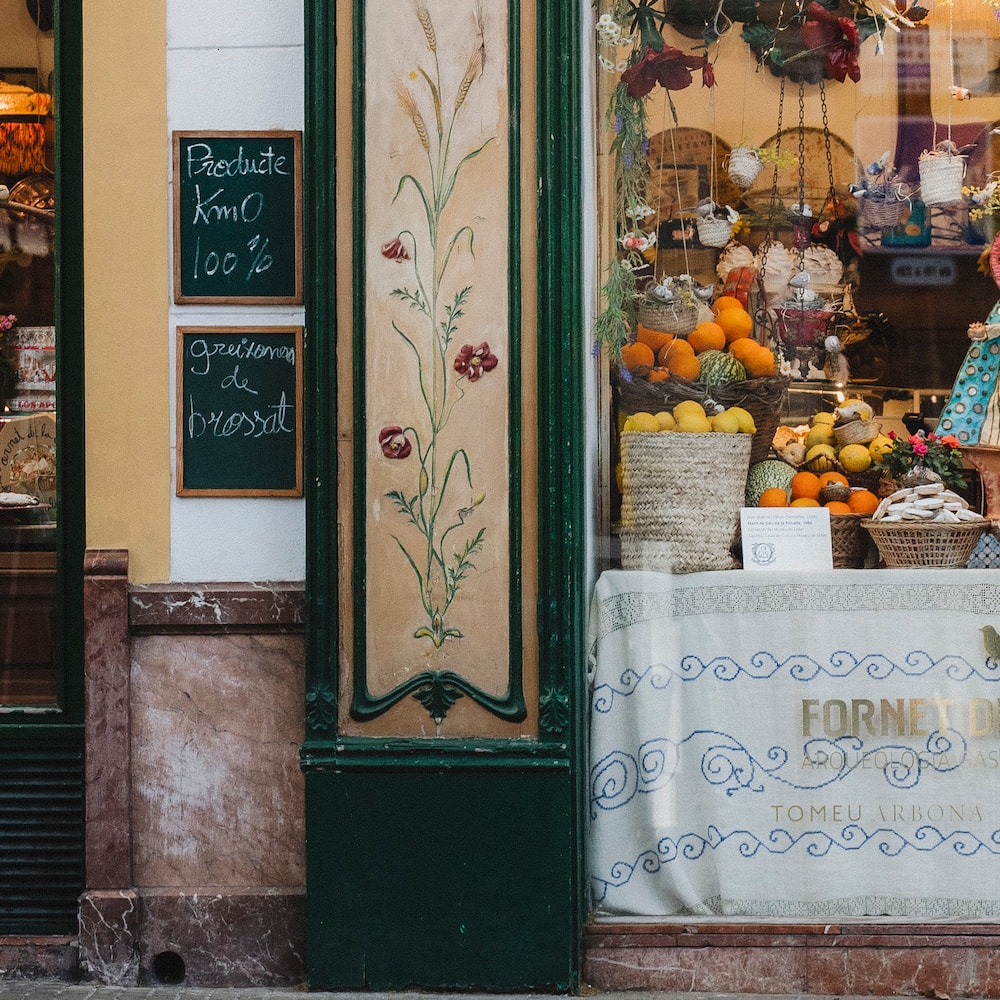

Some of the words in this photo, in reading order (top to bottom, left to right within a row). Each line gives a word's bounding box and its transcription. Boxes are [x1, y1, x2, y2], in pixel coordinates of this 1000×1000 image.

[186, 142, 291, 178] Producte
[220, 364, 259, 395] de
[188, 390, 295, 439] brossat
[1, 426, 25, 466] ornet
[801, 697, 955, 737] FORNET
[771, 804, 863, 823] TOMEU
[872, 803, 984, 823] ARBONA
